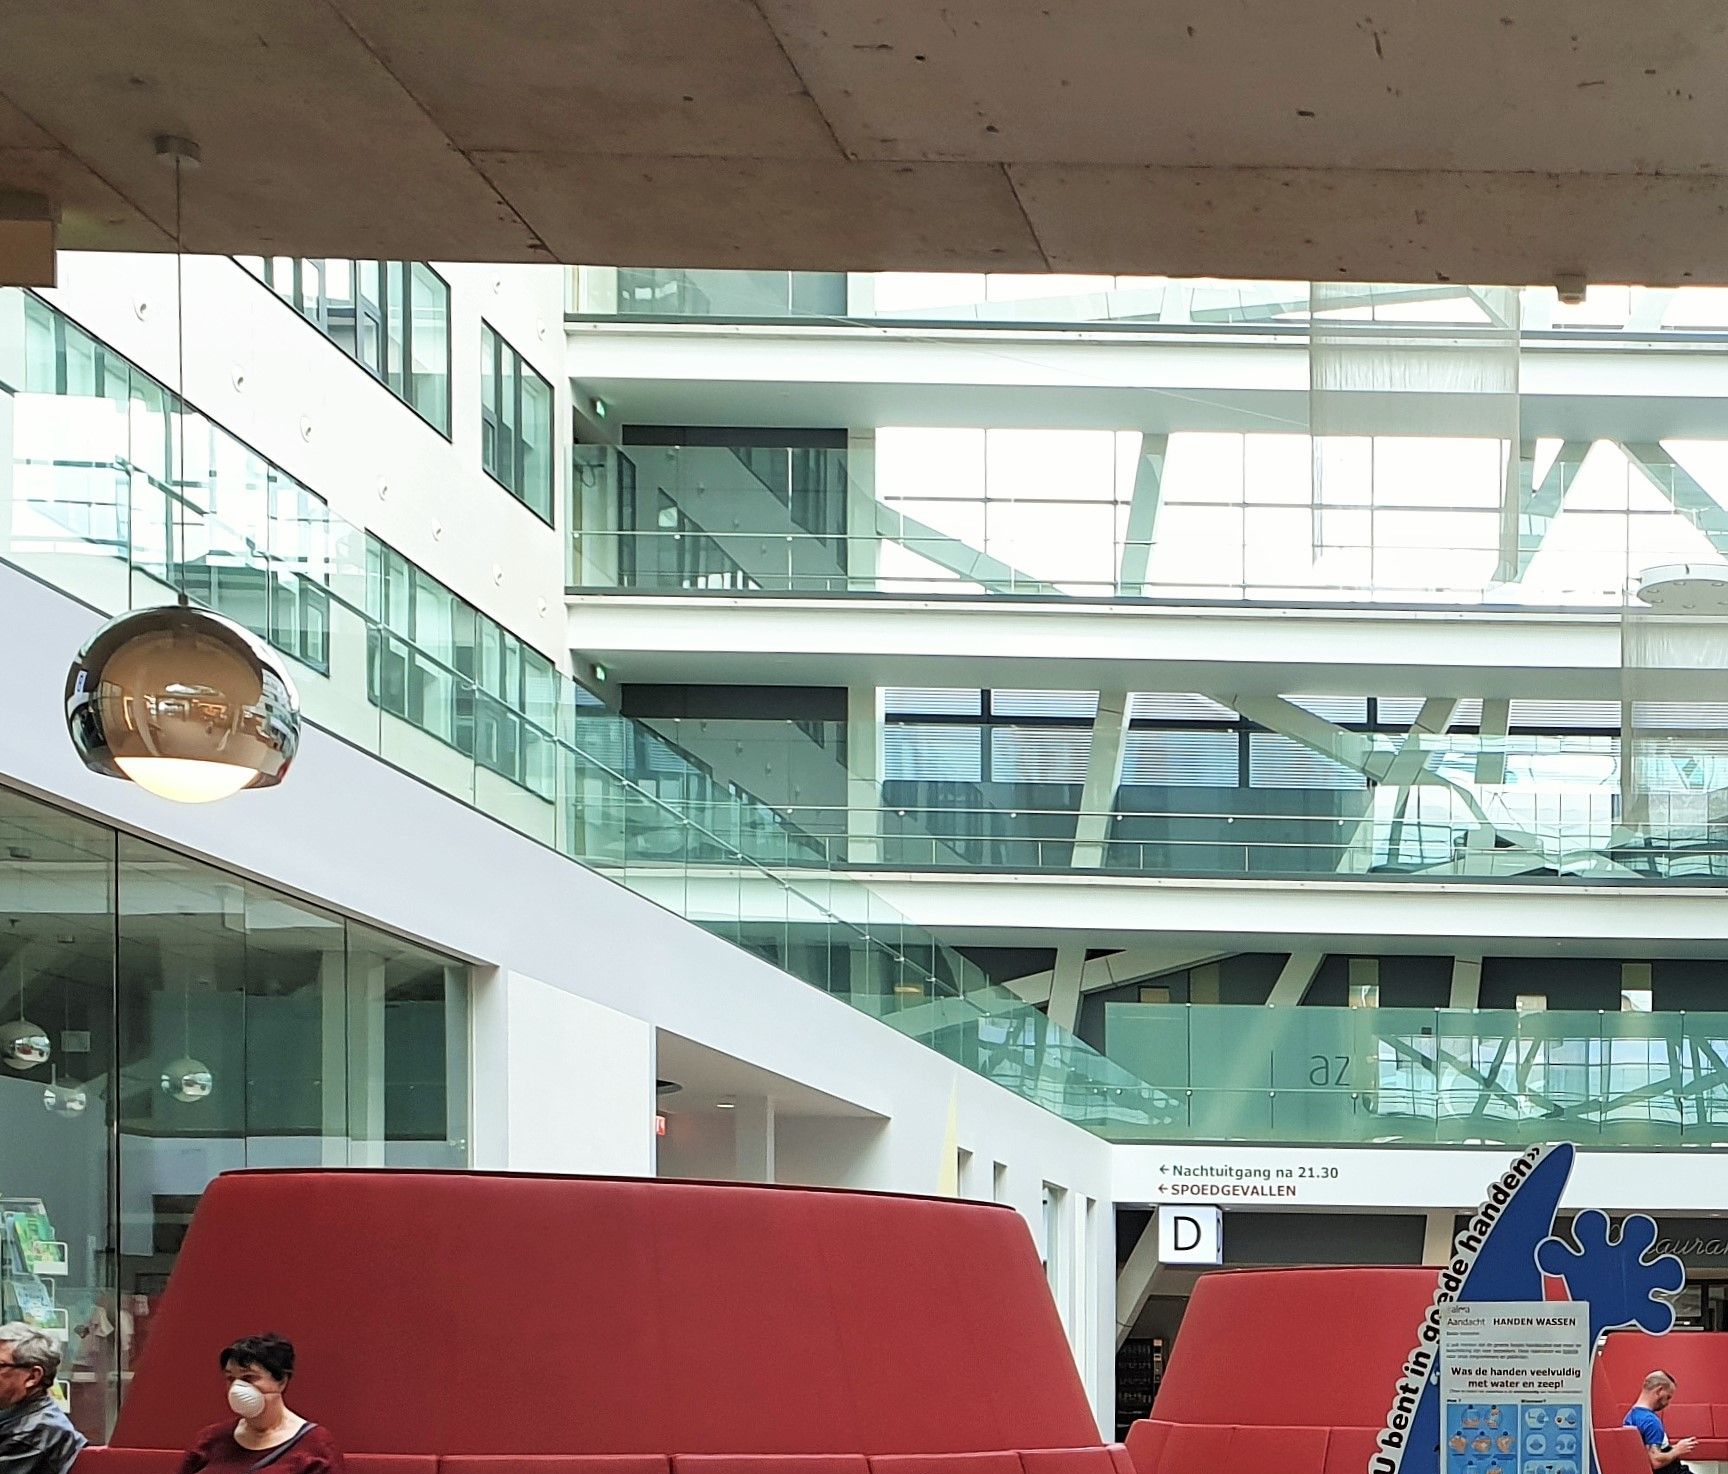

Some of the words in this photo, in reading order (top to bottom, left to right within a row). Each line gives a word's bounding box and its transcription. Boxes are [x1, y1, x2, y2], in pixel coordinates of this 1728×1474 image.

[1308, 1054, 1351, 1087] az
[1172, 1164, 1271, 1180] Nachtuitgang
[1275, 1168, 1293, 1178] na
[1298, 1166, 1339, 1179] 21.30
[1171, 1184, 1297, 1197] SPOEDGEVALLEN
[1173, 1215, 1201, 1252] D
[1380, 1382, 1420, 1449] bent
[1403, 1350, 1432, 1377] in
[1458, 1147, 1541, 1254] handen»
[1447, 1318, 1486, 1326] Aandacht
[1493, 1318, 1534, 1326] HANDEN
[1536, 1318, 1577, 1326] WASSEN
[1450, 1367, 1473, 1376] Was
[1475, 1367, 1488, 1376] de
[1490, 1367, 1527, 1376] handen
[1530, 1367, 1581, 1378] veelvuldig
[1468, 1380, 1488, 1388] met
[1490, 1380, 1519, 1388] water
[1537, 1380, 1564, 1389] zeep!
